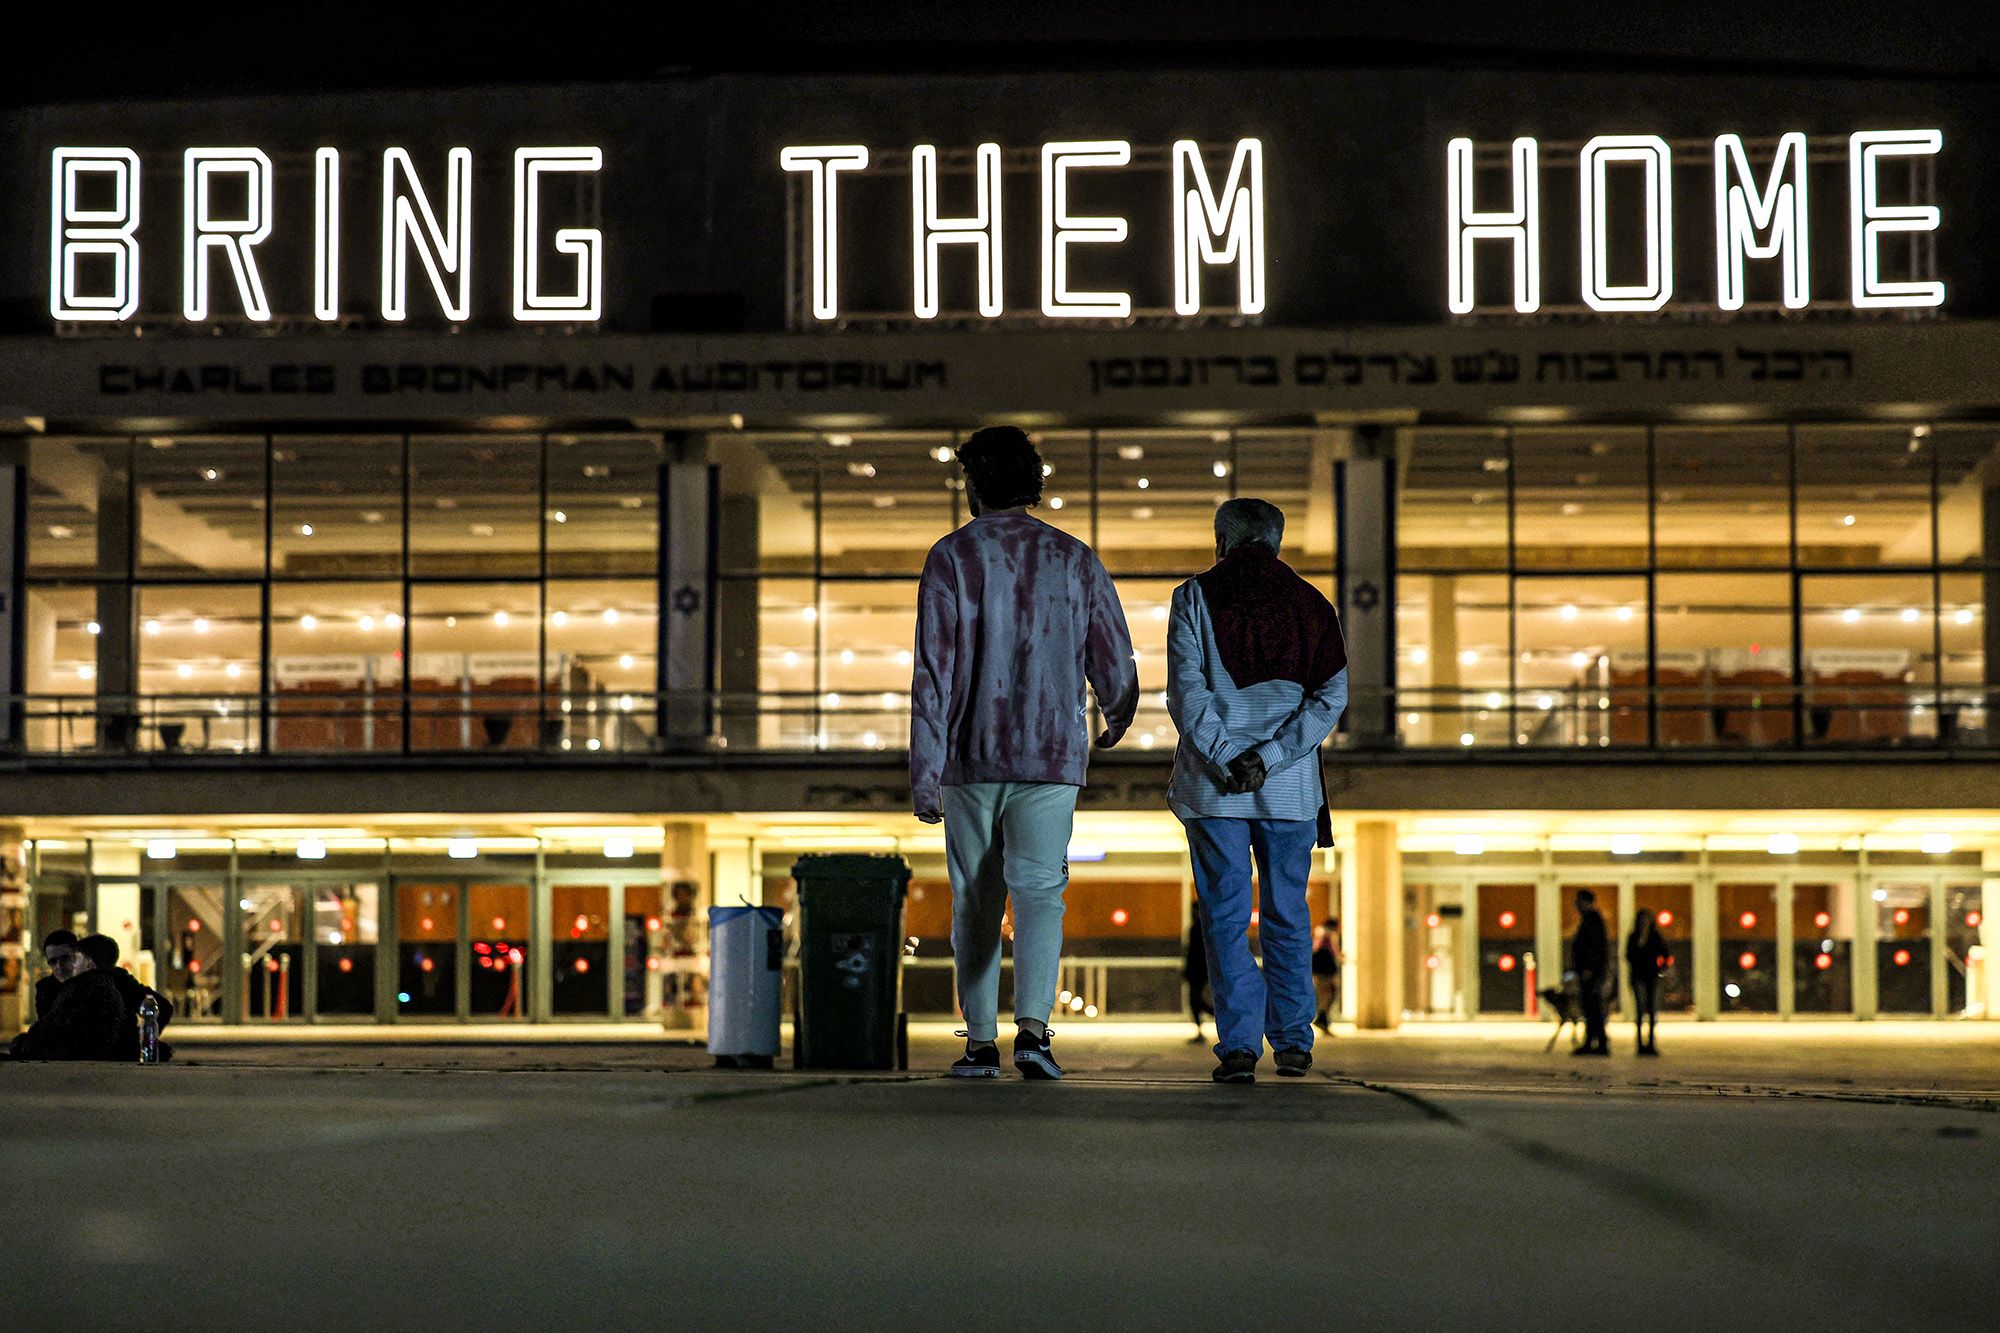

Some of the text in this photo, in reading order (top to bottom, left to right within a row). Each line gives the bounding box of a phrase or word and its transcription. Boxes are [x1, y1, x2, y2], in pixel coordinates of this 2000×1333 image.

[49, 129, 1946, 322] BRING THEM HOME
[99, 359, 947, 395] CHARLES BRONFMAN AUDITORIUM
[1536, 350, 1725, 383] התרבות
[1736, 346, 1853, 381] היכל
